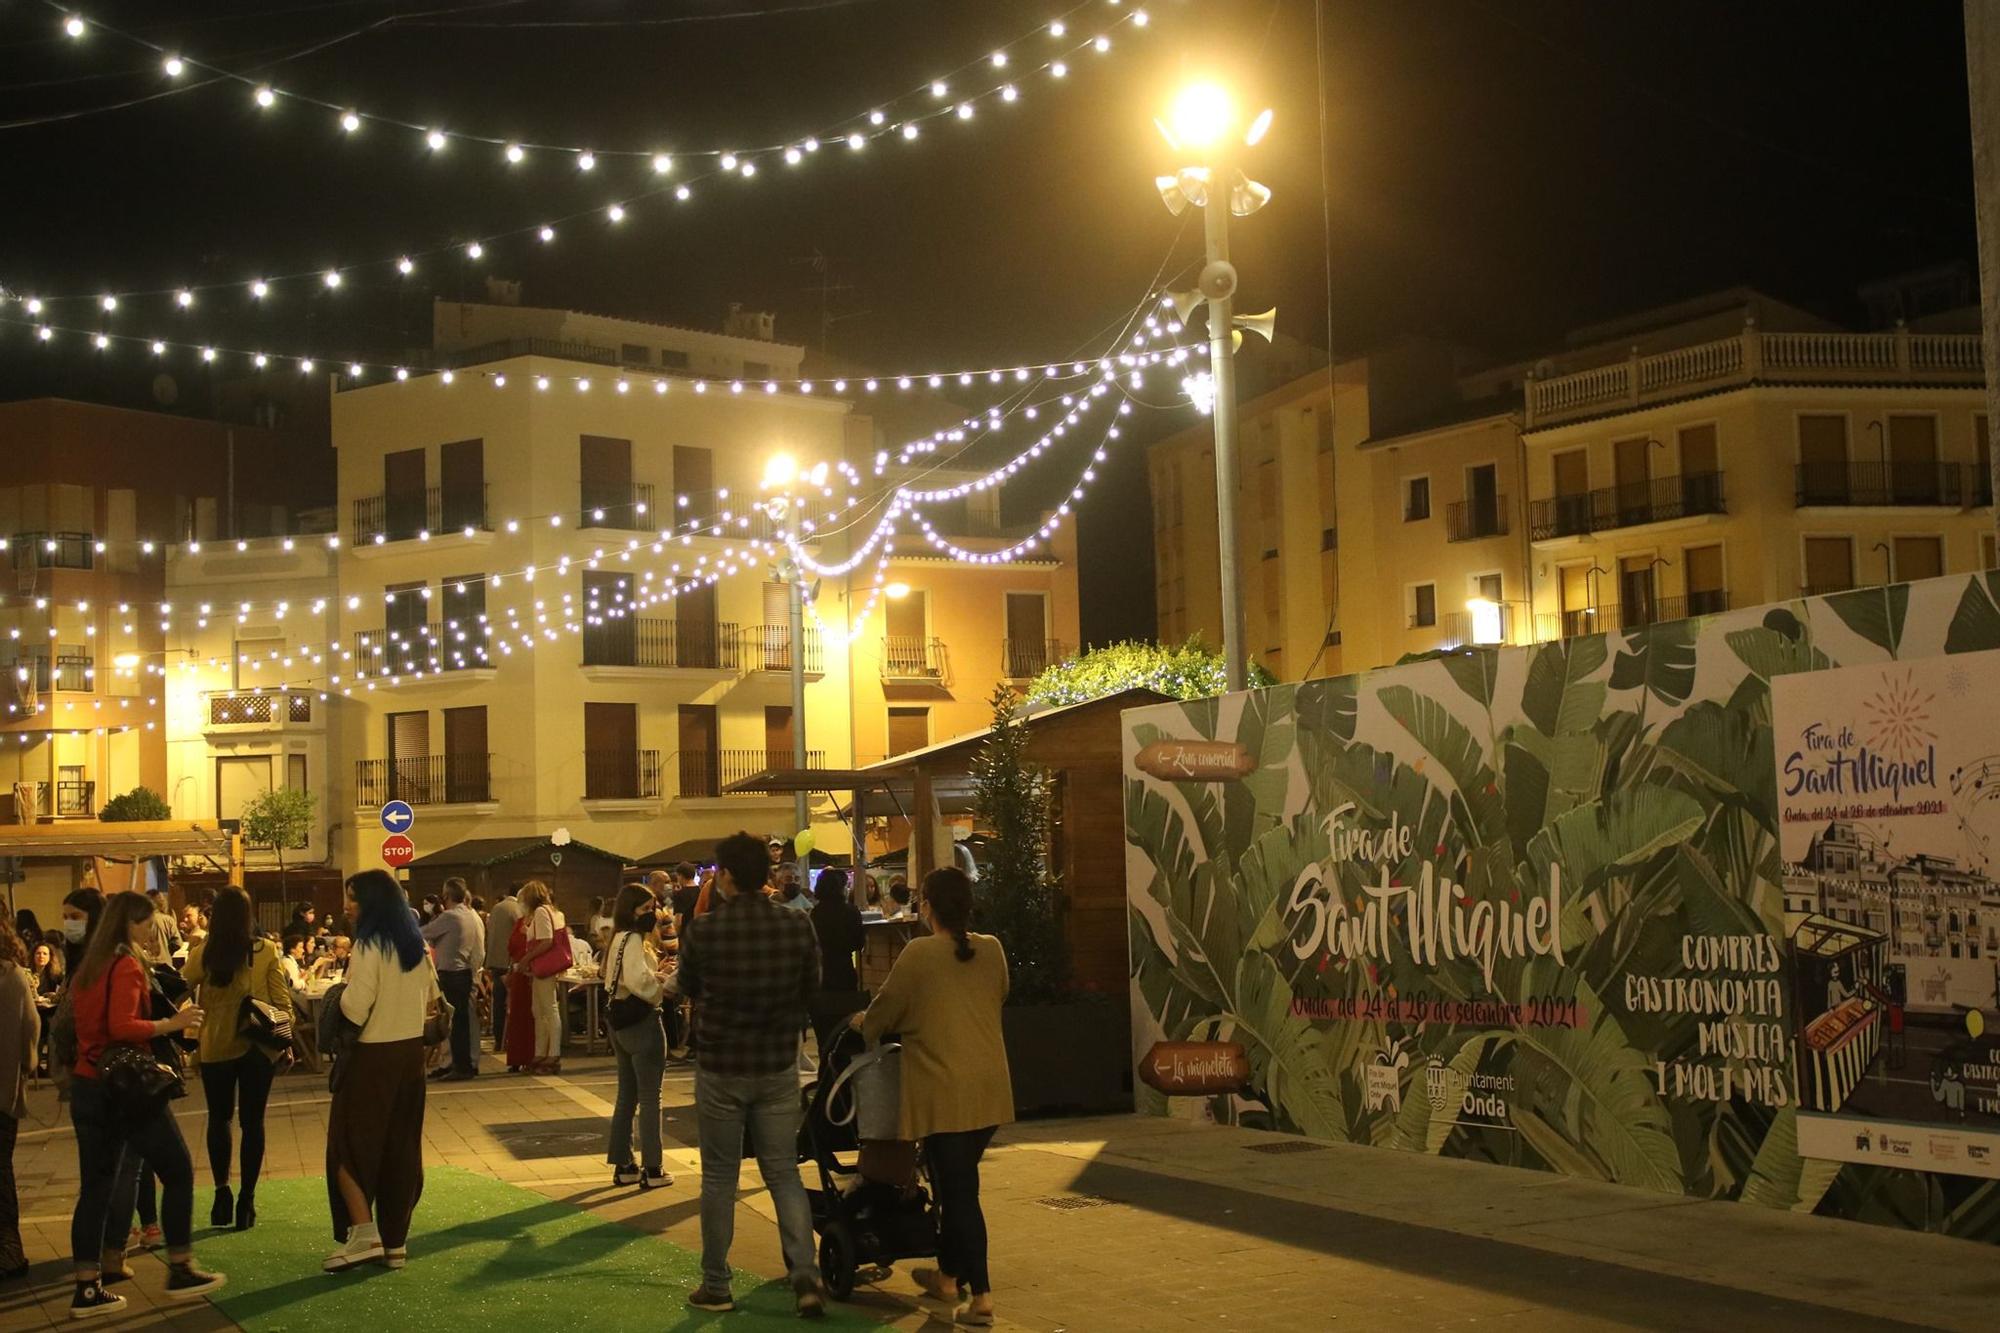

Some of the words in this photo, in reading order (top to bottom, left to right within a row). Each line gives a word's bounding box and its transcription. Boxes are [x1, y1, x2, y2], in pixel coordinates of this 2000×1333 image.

[1802, 723, 1834, 750] Fira
[1838, 726, 1854, 748] de
[1199, 748, 1236, 769] comercial
[1784, 751, 1851, 797] Sant
[1851, 745, 1936, 802] Miquel
[1825, 806, 1837, 820] 24
[1850, 805, 1864, 818] 26
[1916, 800, 1943, 815] 2021
[1319, 801, 1378, 862] Fira
[1383, 810, 1414, 864] de
[384, 847, 412, 856] STOP
[1292, 862, 1412, 965] Sant
[1407, 860, 1565, 993] Miquel
[1682, 933, 1781, 972] COMPRES
[1338, 991, 1356, 1019] del
[1362, 990, 1382, 1018] 24
[1406, 991, 1427, 1021] 26
[1433, 993, 1451, 1021] de
[1456, 994, 1523, 1025] setembre
[1529, 995, 1577, 1029] 2021
[1625, 973, 1783, 1018] GASTRONOMIA
[1172, 1053, 1185, 1083] La
[1453, 1071, 1515, 1092] Ajuntament
[1656, 1061, 1668, 1096] I
[1675, 1063, 1734, 1101] MOLT
[1463, 1091, 1506, 1117] Onda
